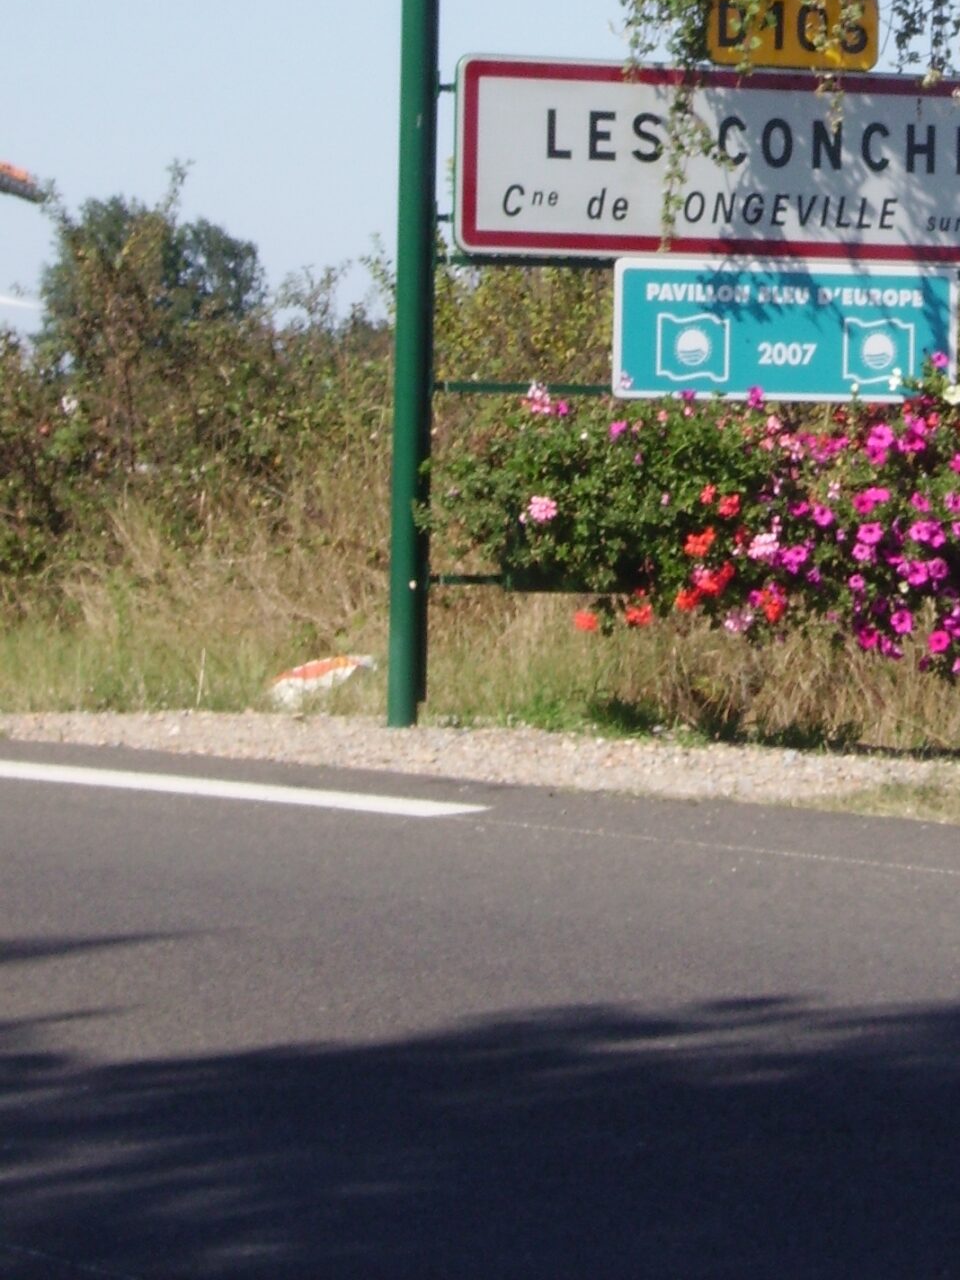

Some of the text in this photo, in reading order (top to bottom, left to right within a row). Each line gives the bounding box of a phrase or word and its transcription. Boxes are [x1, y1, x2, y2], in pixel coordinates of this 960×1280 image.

[546, 108, 664, 163] LES
[502, 184, 560, 218] Cne
[586, 187, 630, 222] de
[664, 190, 899, 231] ONGEVILLE
[645, 282, 924, 308] PAVILLON BLEU D'EUROPE
[757, 341, 818, 367] 2007
